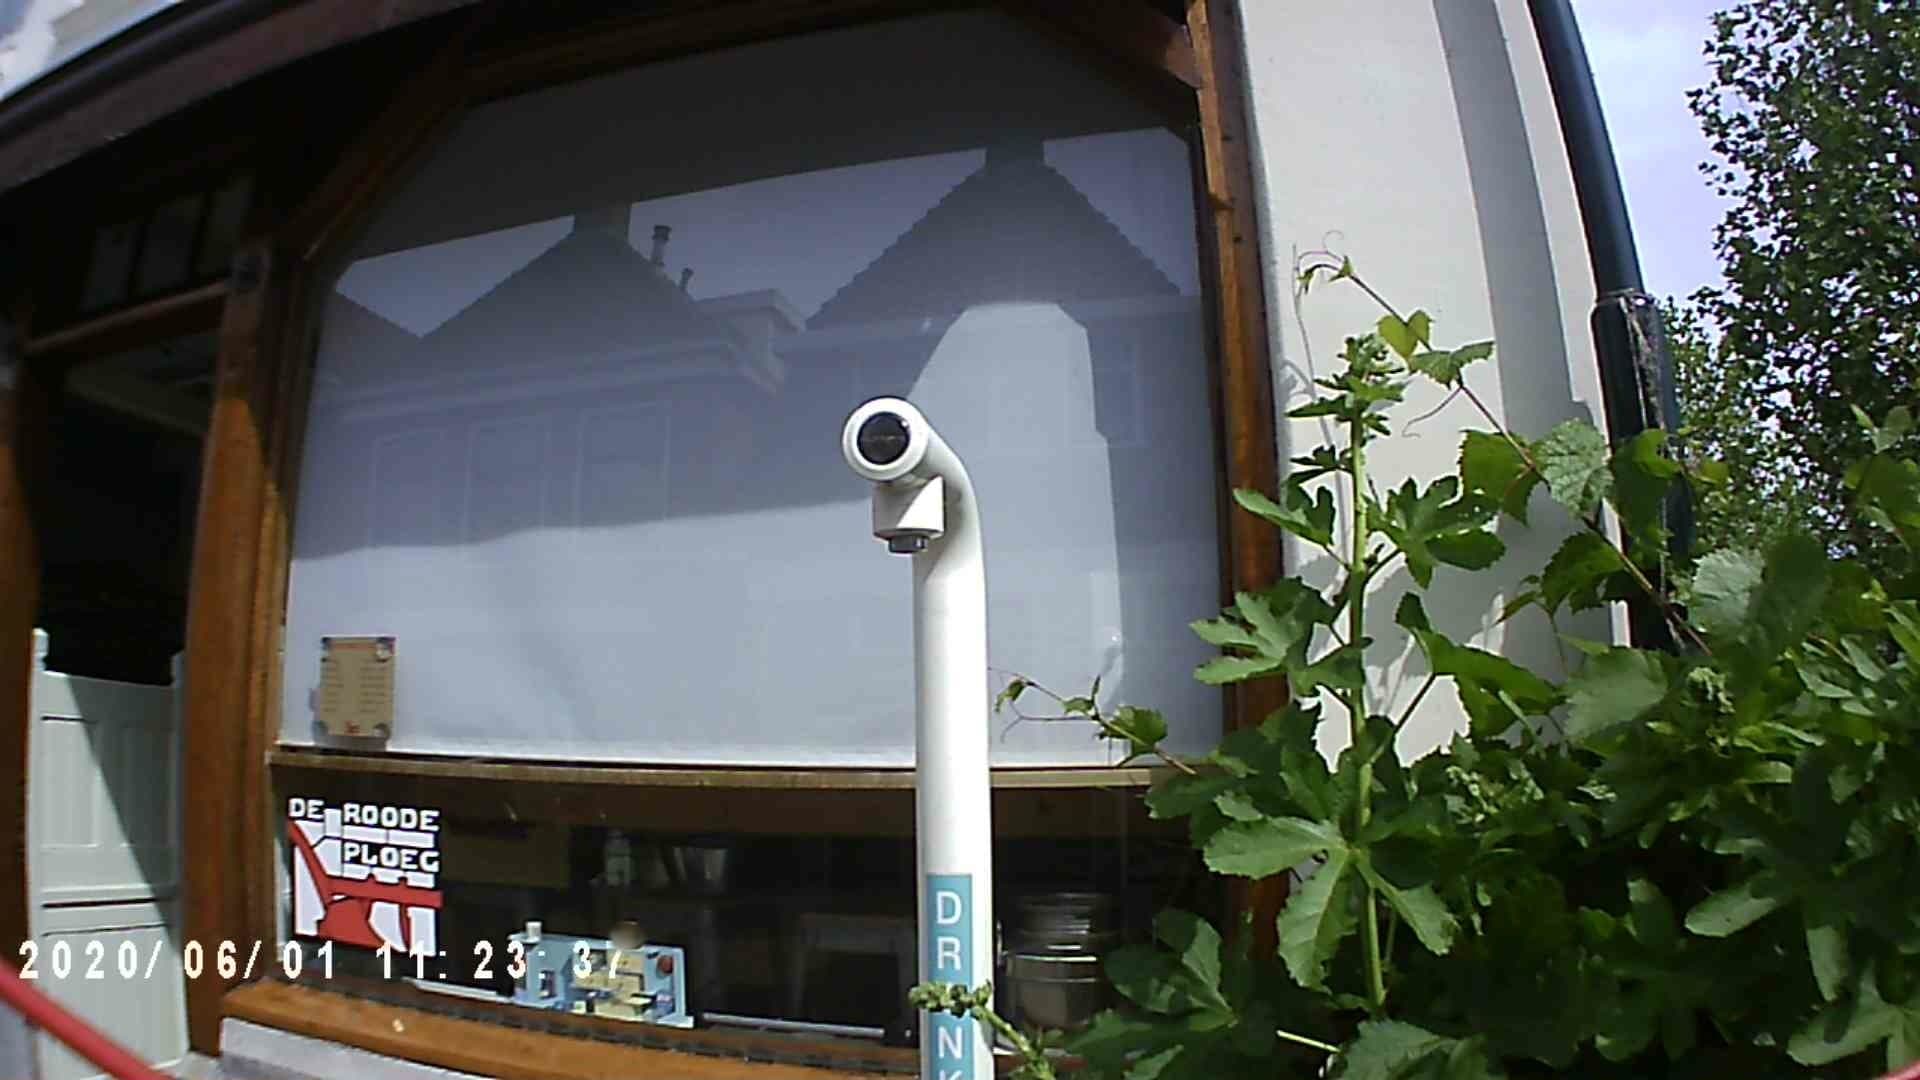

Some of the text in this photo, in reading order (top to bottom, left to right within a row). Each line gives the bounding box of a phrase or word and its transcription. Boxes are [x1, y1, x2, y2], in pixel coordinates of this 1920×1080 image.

[288, 798, 440, 831] DE ROODE
[343, 842, 440, 872] PLOEG
[936, 891, 964, 1080] DRN
